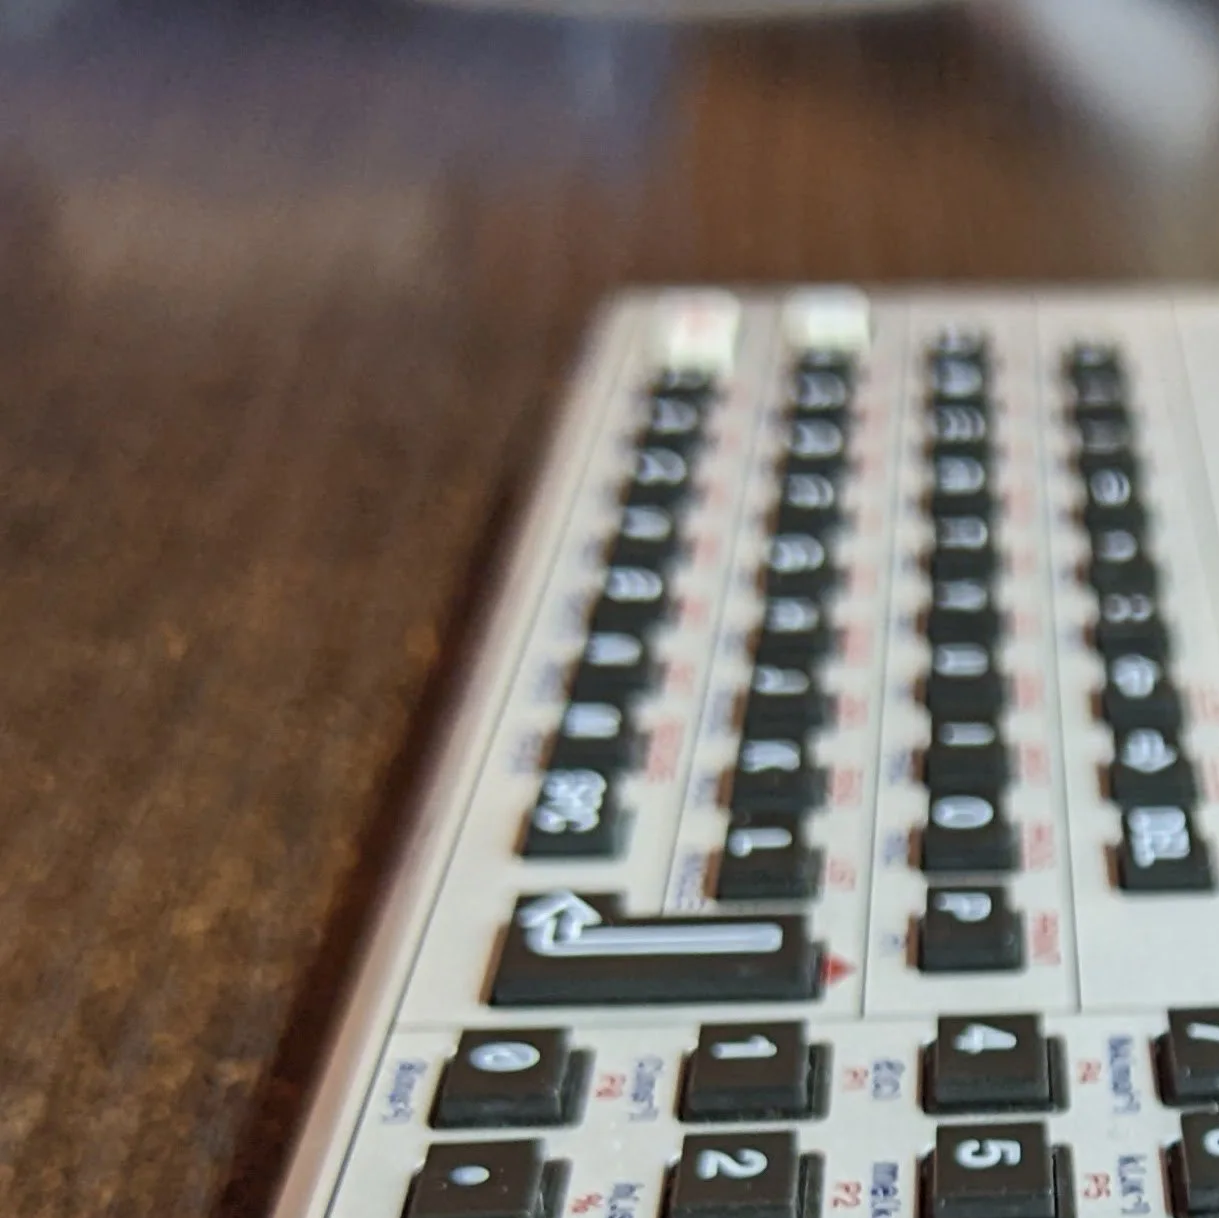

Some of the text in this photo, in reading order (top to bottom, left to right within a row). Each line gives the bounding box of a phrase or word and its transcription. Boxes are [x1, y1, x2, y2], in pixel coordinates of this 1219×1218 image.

[710, 1034, 779, 1060] 1
[955, 1022, 1018, 1054] 4
[467, 1040, 541, 1073] 0
[696, 1148, 768, 1181] 2
[955, 1138, 1022, 1169] 5
